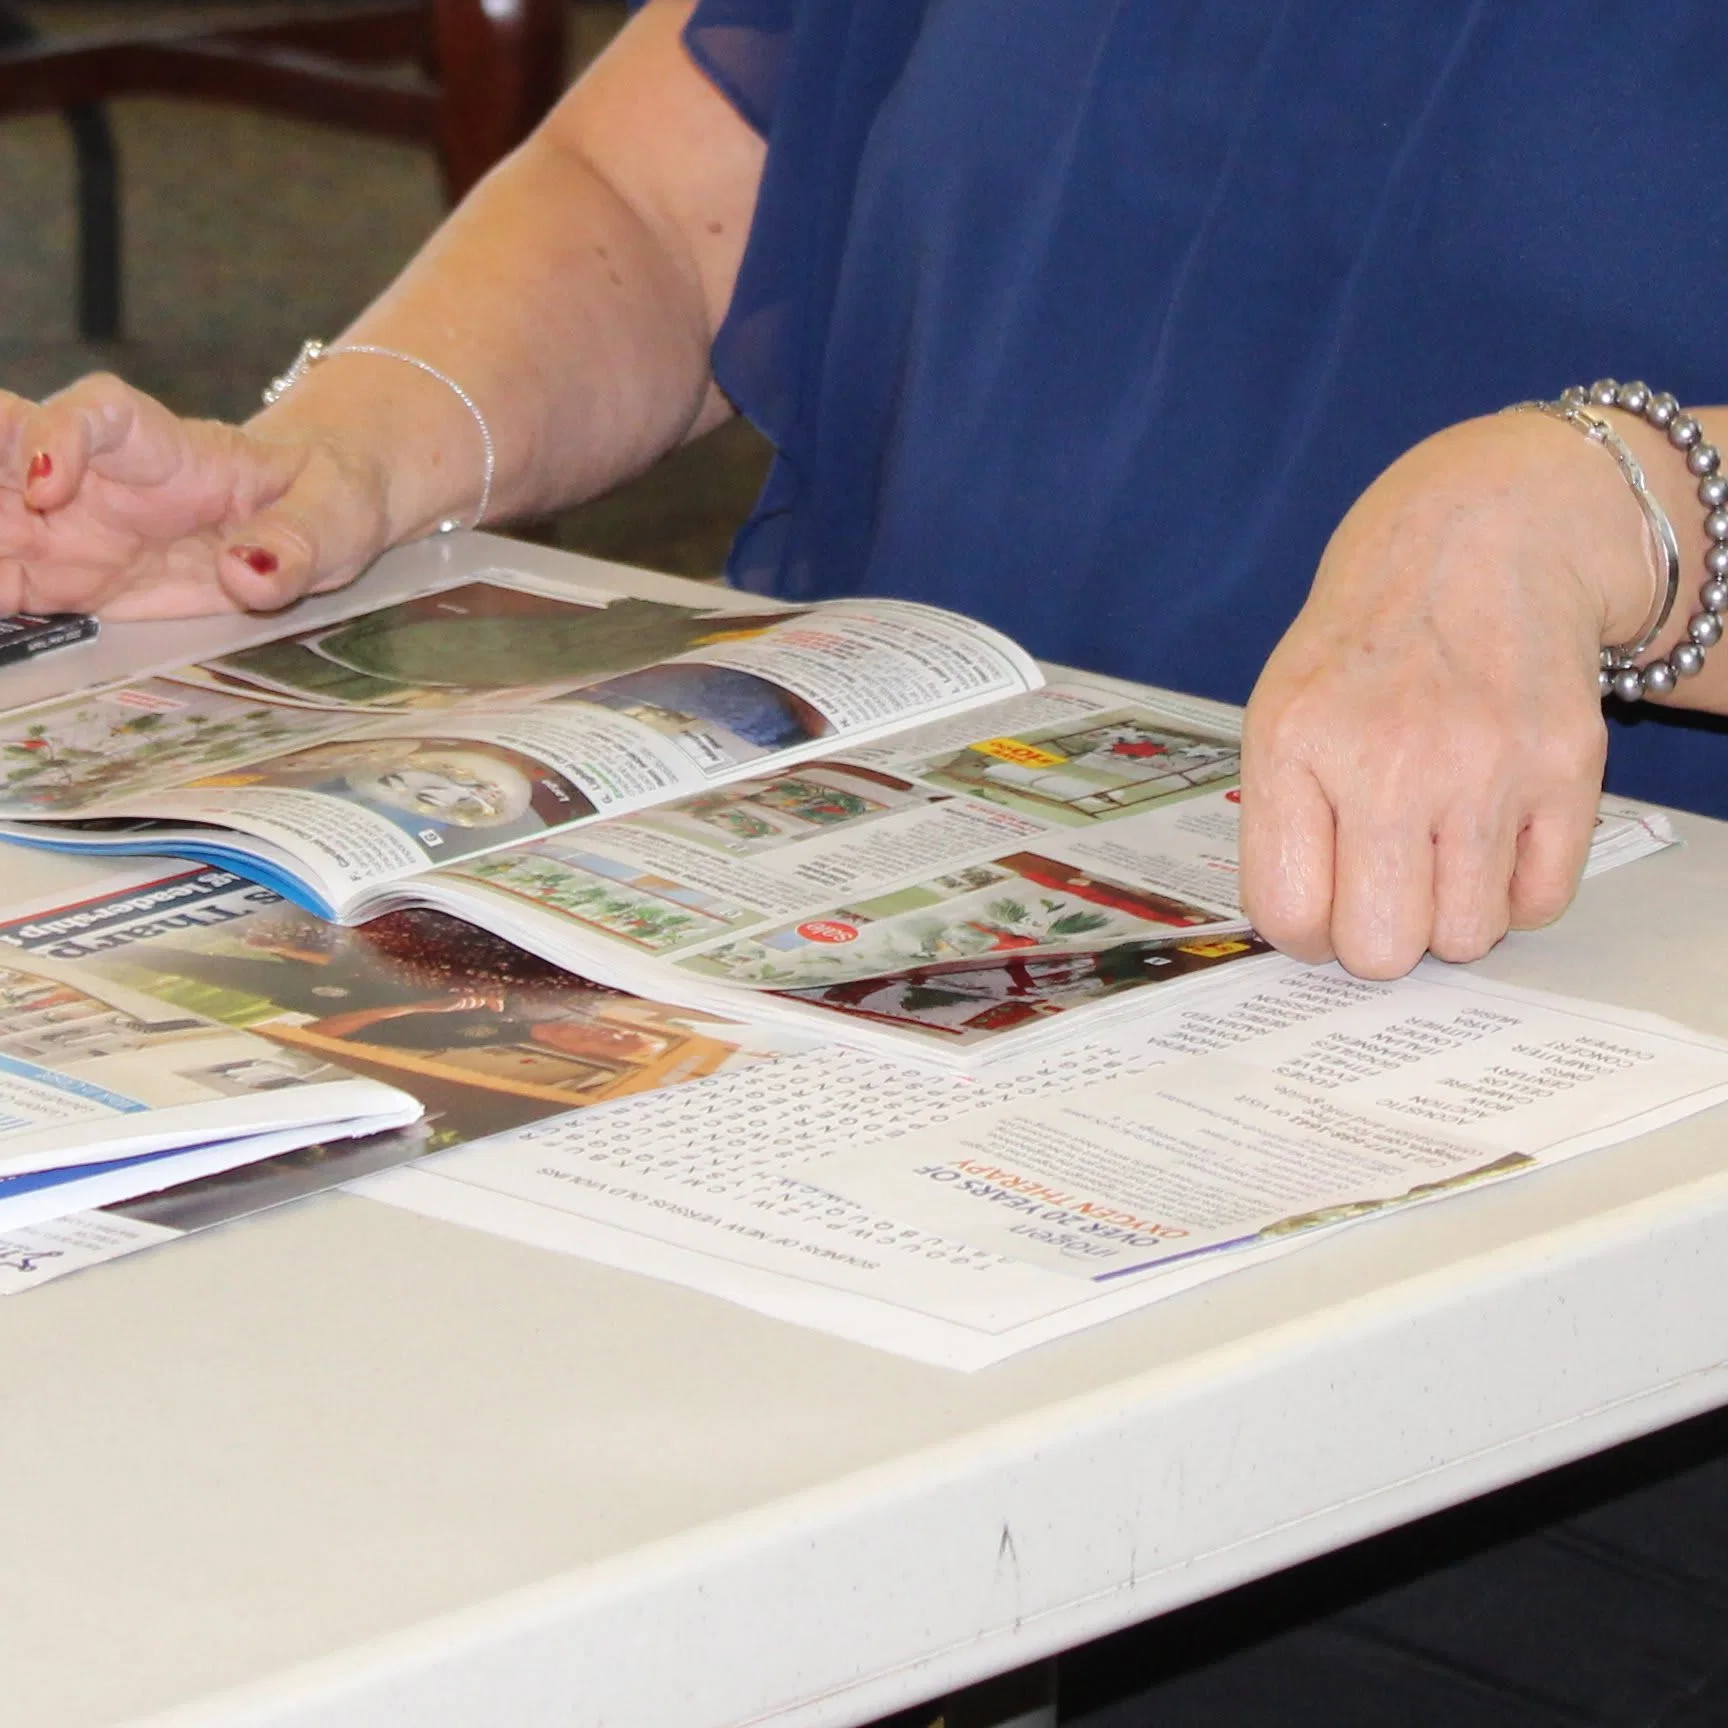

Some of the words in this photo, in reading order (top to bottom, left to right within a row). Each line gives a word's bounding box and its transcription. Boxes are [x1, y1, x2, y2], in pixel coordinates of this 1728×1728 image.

[18, 879, 204, 940] leadership
[46, 904, 258, 961] Tharp
[1251, 994, 1333, 1014] SESSION
[1288, 992, 1353, 1008] SOUND
[1307, 984, 1373, 1001] SOUND
[1236, 1002, 1313, 1021] SCREEN
[1179, 1022, 1252, 1042] POWER
[1180, 1011, 1273, 1036] RADIATED
[1404, 1016, 1484, 1040] LUTHIER
[1452, 1016, 1503, 1033] LYRA
[1146, 1037, 1209, 1056] OPERA
[1169, 1032, 1231, 1050] PHONE
[1369, 1032, 1443, 1055] ITALIAN
[1384, 1024, 1463, 1048] LOUDER
[1511, 1044, 1616, 1074] COMPUTER
[1543, 1040, 1635, 1068] CONCERT
[1271, 1067, 1340, 1089] EDGES
[1283, 1059, 1361, 1082] EVOLVE
[1484, 1065, 1576, 1090] CENTURY
[1478, 1076, 1555, 1098] CELLOS
[1375, 1099, 1472, 1126] ACOUSTIC
[1408, 1096, 1489, 1118] AUCTION
[1464, 1097, 1515, 1112] BOW
[535, 1168, 609, 1192] VIOLINS
[912, 1166, 962, 1182] OF
[950, 1160, 1076, 1206] THERAPY
[607, 1188, 649, 1201] OLD
[954, 1180, 1044, 1215] YEARS
[647, 1199, 722, 1226] VERSUS
[1040, 1211, 1086, 1226] 20
[1070, 1202, 1191, 1238] OXYGEN
[722, 1224, 773, 1240] NEW
[769, 1238, 800, 1247] OF
[1078, 1222, 1160, 1247] OVER
[799, 1245, 881, 1270] SOUNDS
